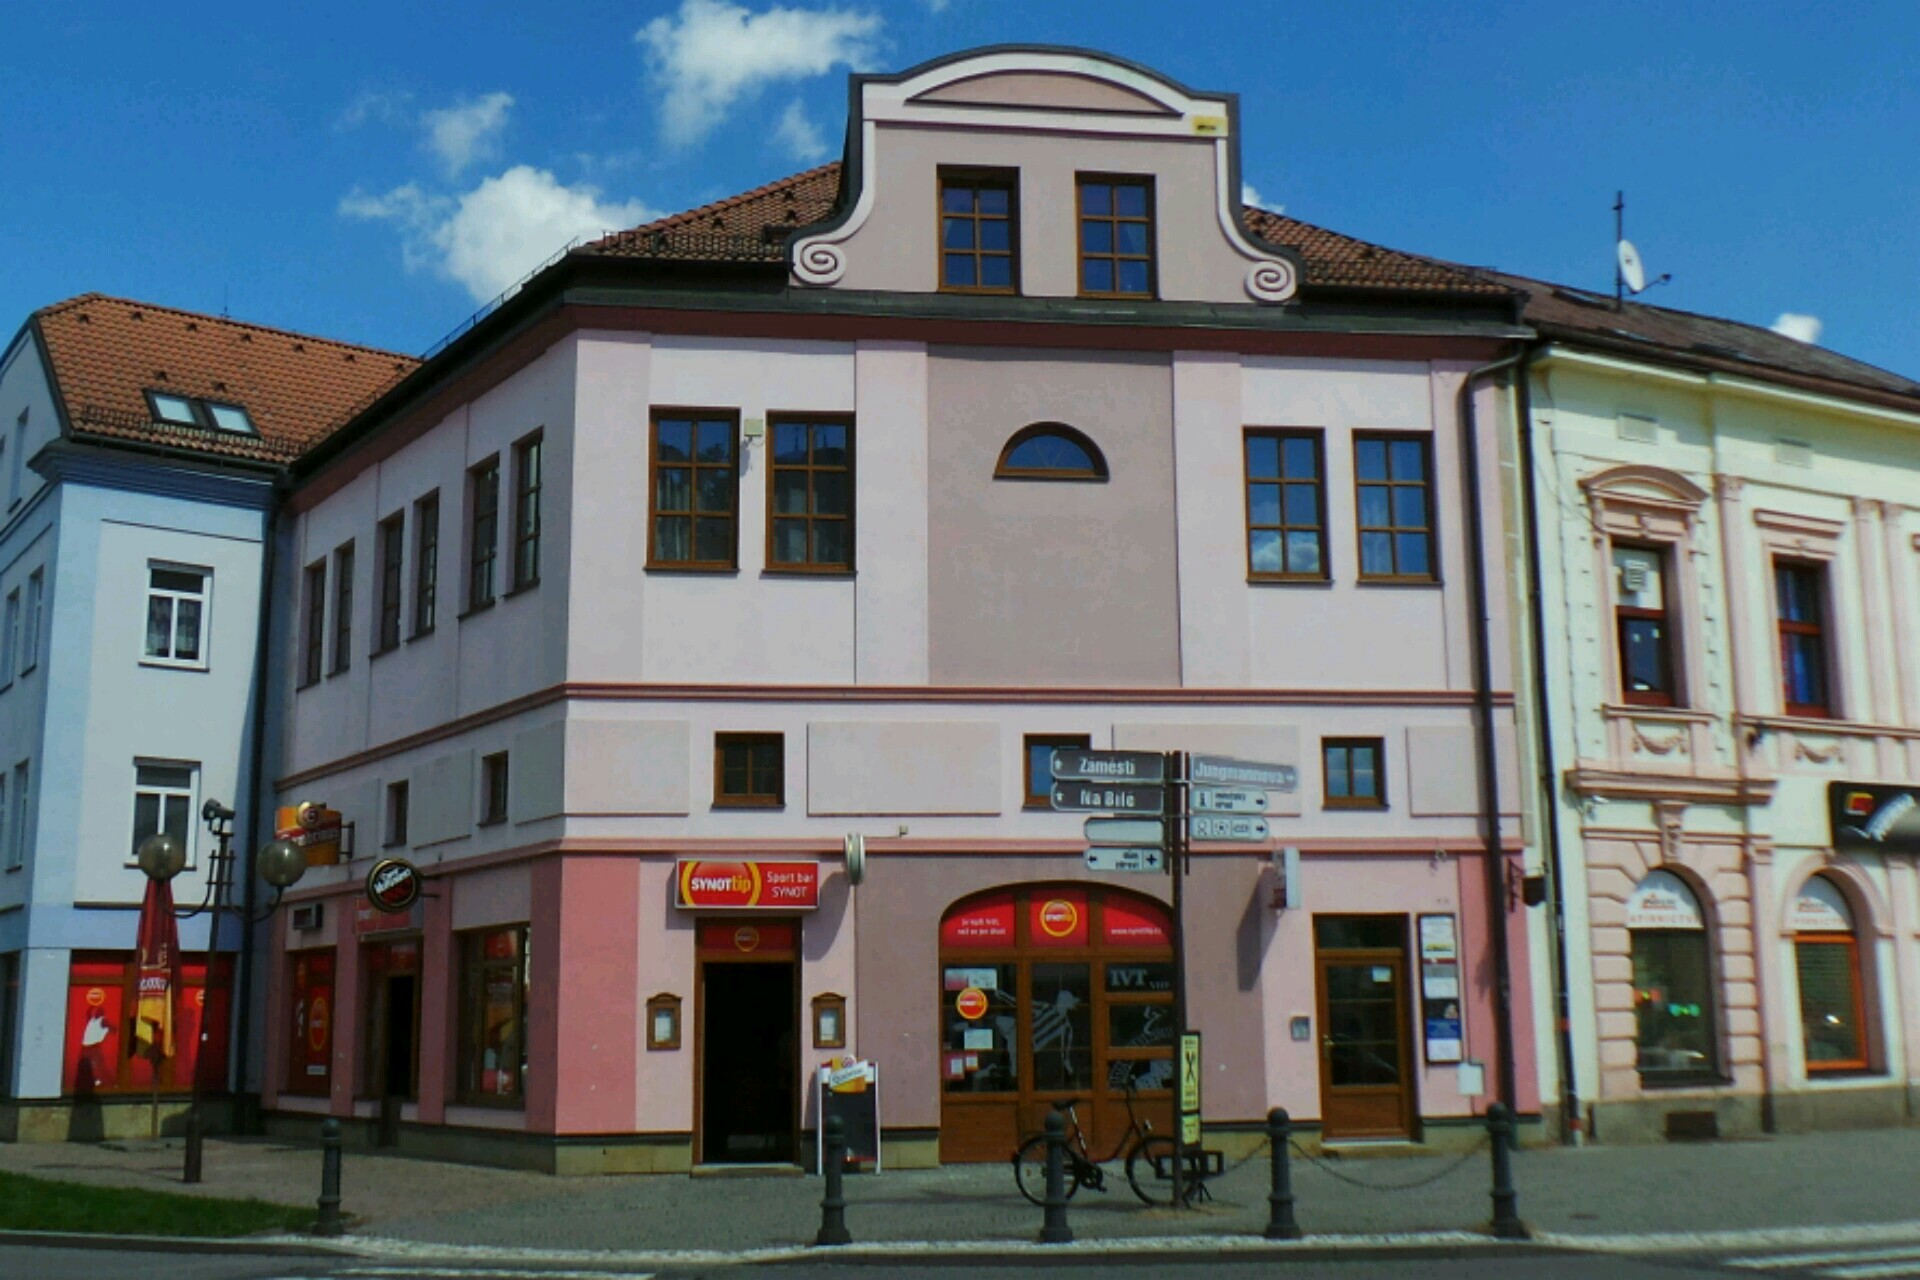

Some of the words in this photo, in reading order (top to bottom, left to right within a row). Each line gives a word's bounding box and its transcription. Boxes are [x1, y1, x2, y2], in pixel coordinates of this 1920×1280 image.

[1195, 762, 1285, 783] Jungmannova
[1080, 790, 1101, 806] Na
[767, 872, 795, 884] Sport
[797, 872, 814, 883] bar
[771, 886, 808, 898] SYNOT
[1110, 968, 1147, 987] IVT
